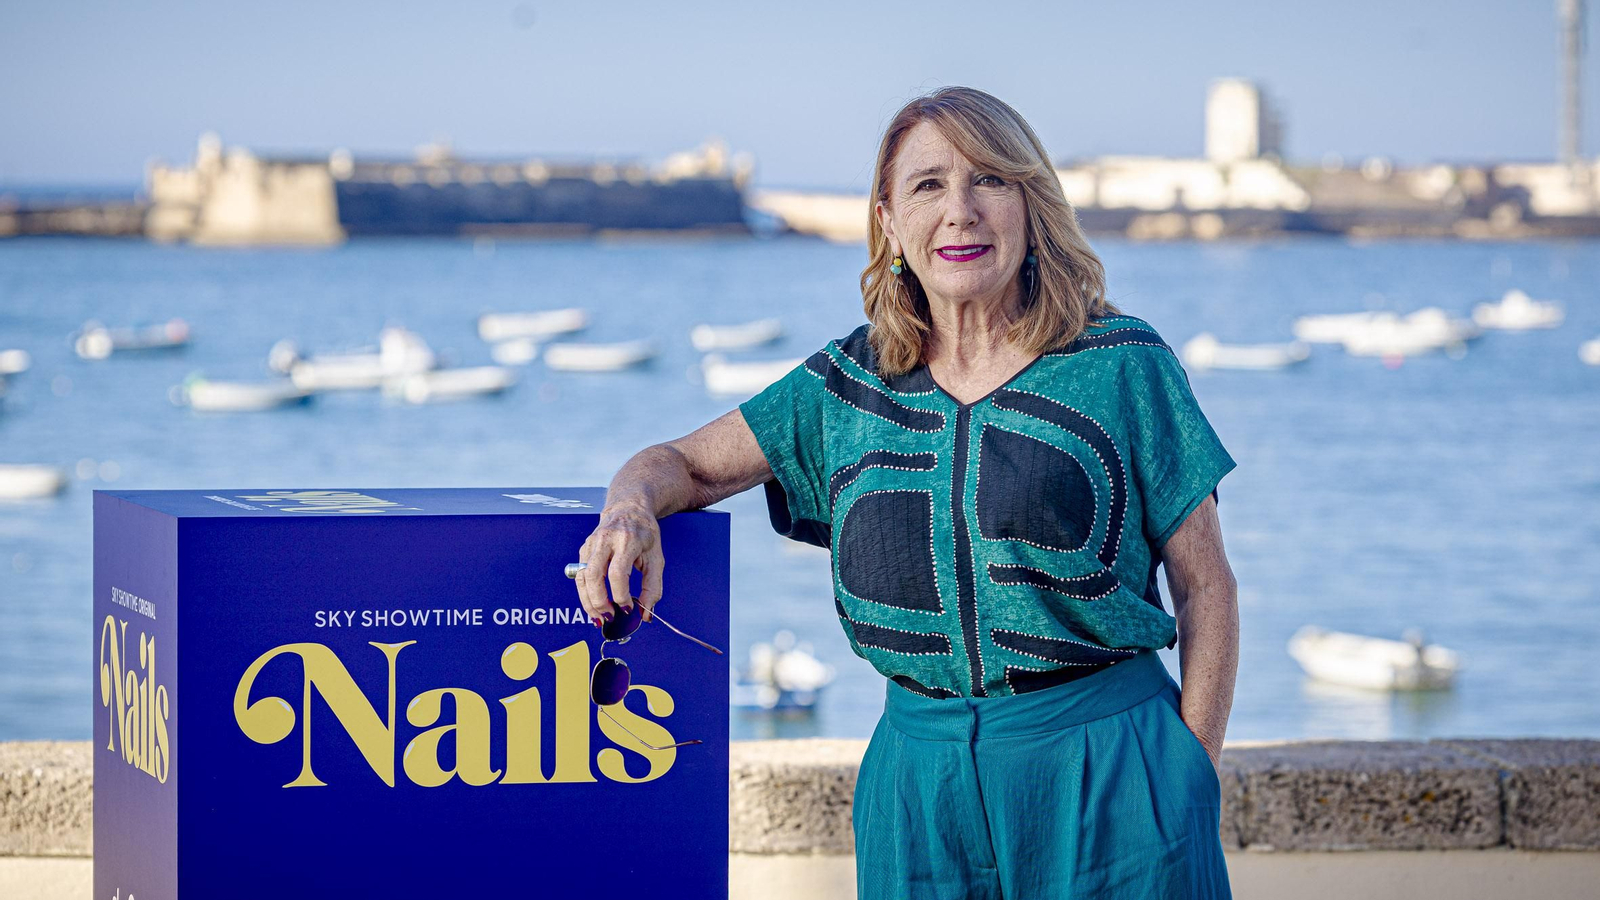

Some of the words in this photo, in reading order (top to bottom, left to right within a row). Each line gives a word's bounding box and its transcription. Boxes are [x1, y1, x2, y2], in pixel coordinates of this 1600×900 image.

[111, 586, 119, 604] SKY
[118, 589, 138, 612] SHOWTIME
[138, 597, 156, 620] ORIGINAL
[314, 610, 356, 628] SKY
[361, 608, 483, 627] SHOWTIME
[100, 614, 169, 784] Nails
[233, 640, 677, 789] Nails
